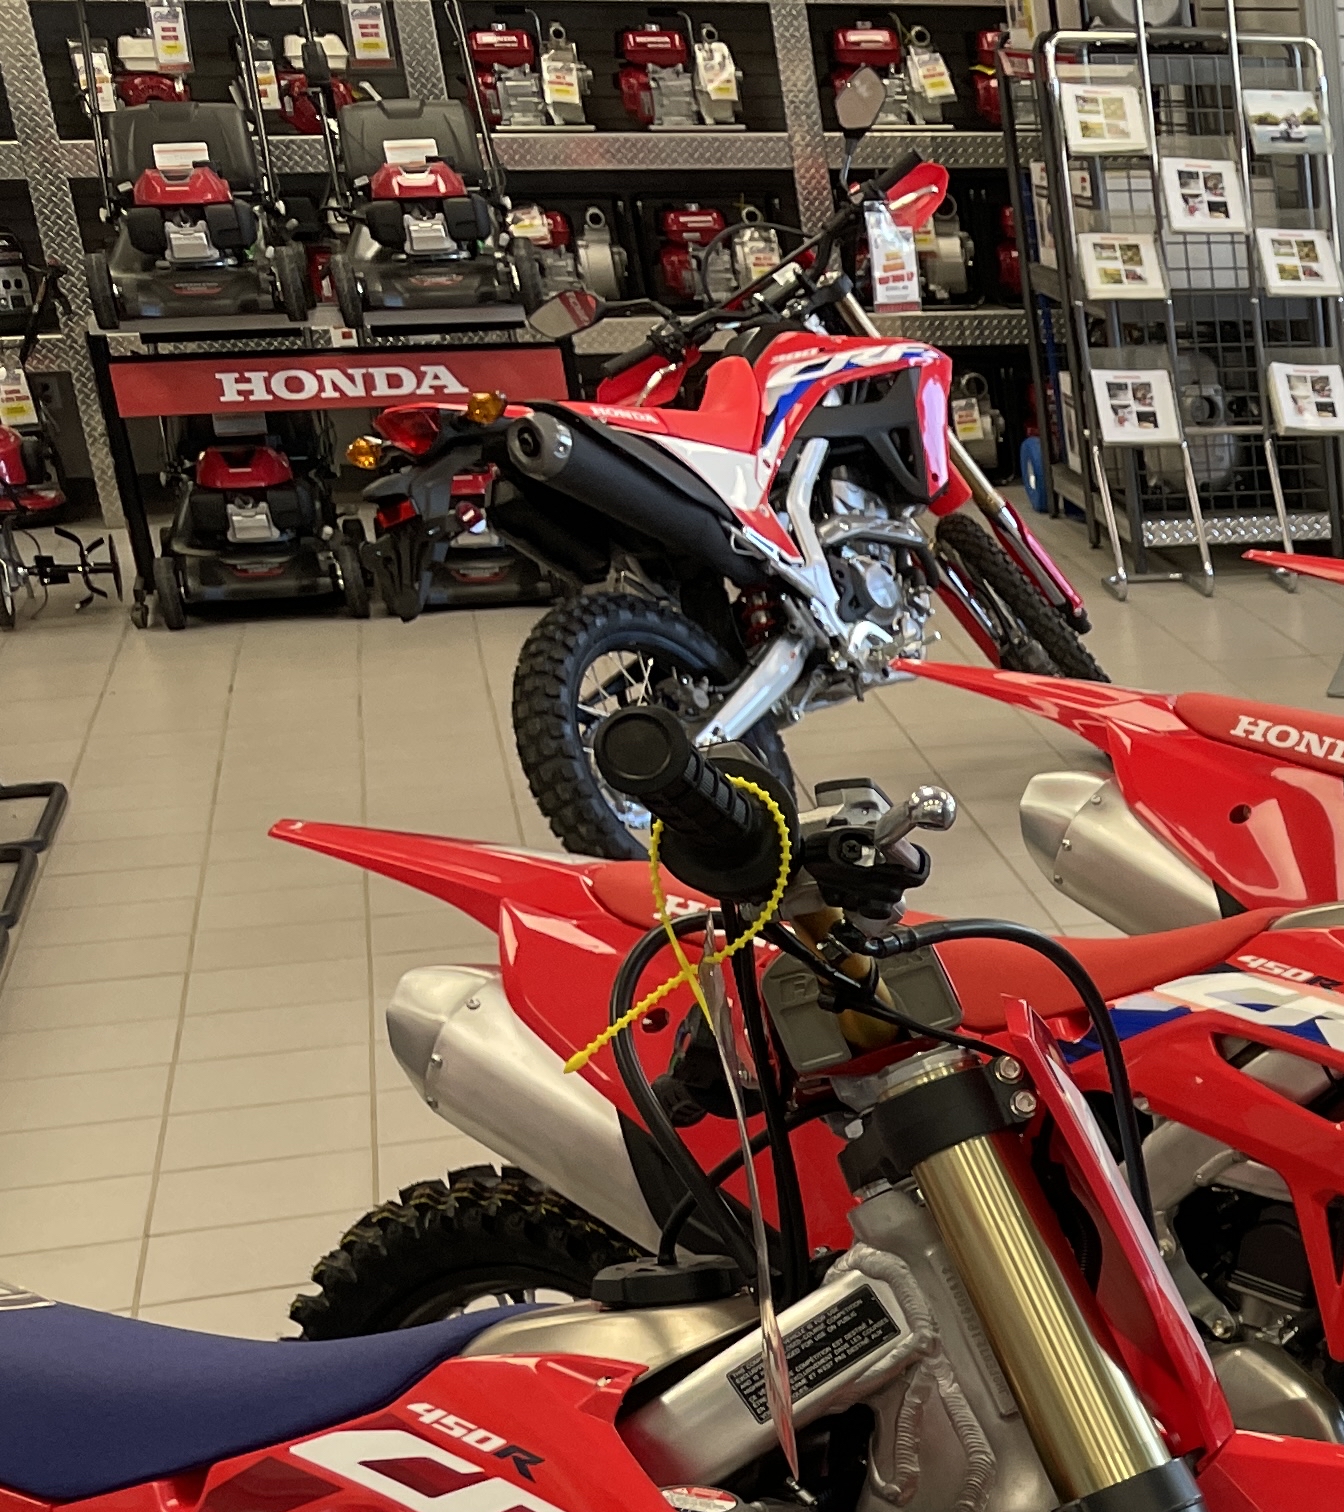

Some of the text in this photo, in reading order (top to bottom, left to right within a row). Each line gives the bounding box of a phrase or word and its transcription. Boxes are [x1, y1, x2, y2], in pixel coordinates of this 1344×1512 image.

[214, 364, 469, 402] HONDA
[590, 405, 659, 424] HONDA
[1237, 954, 1344, 991] 450R
[407, 1402, 546, 1482] 450R
